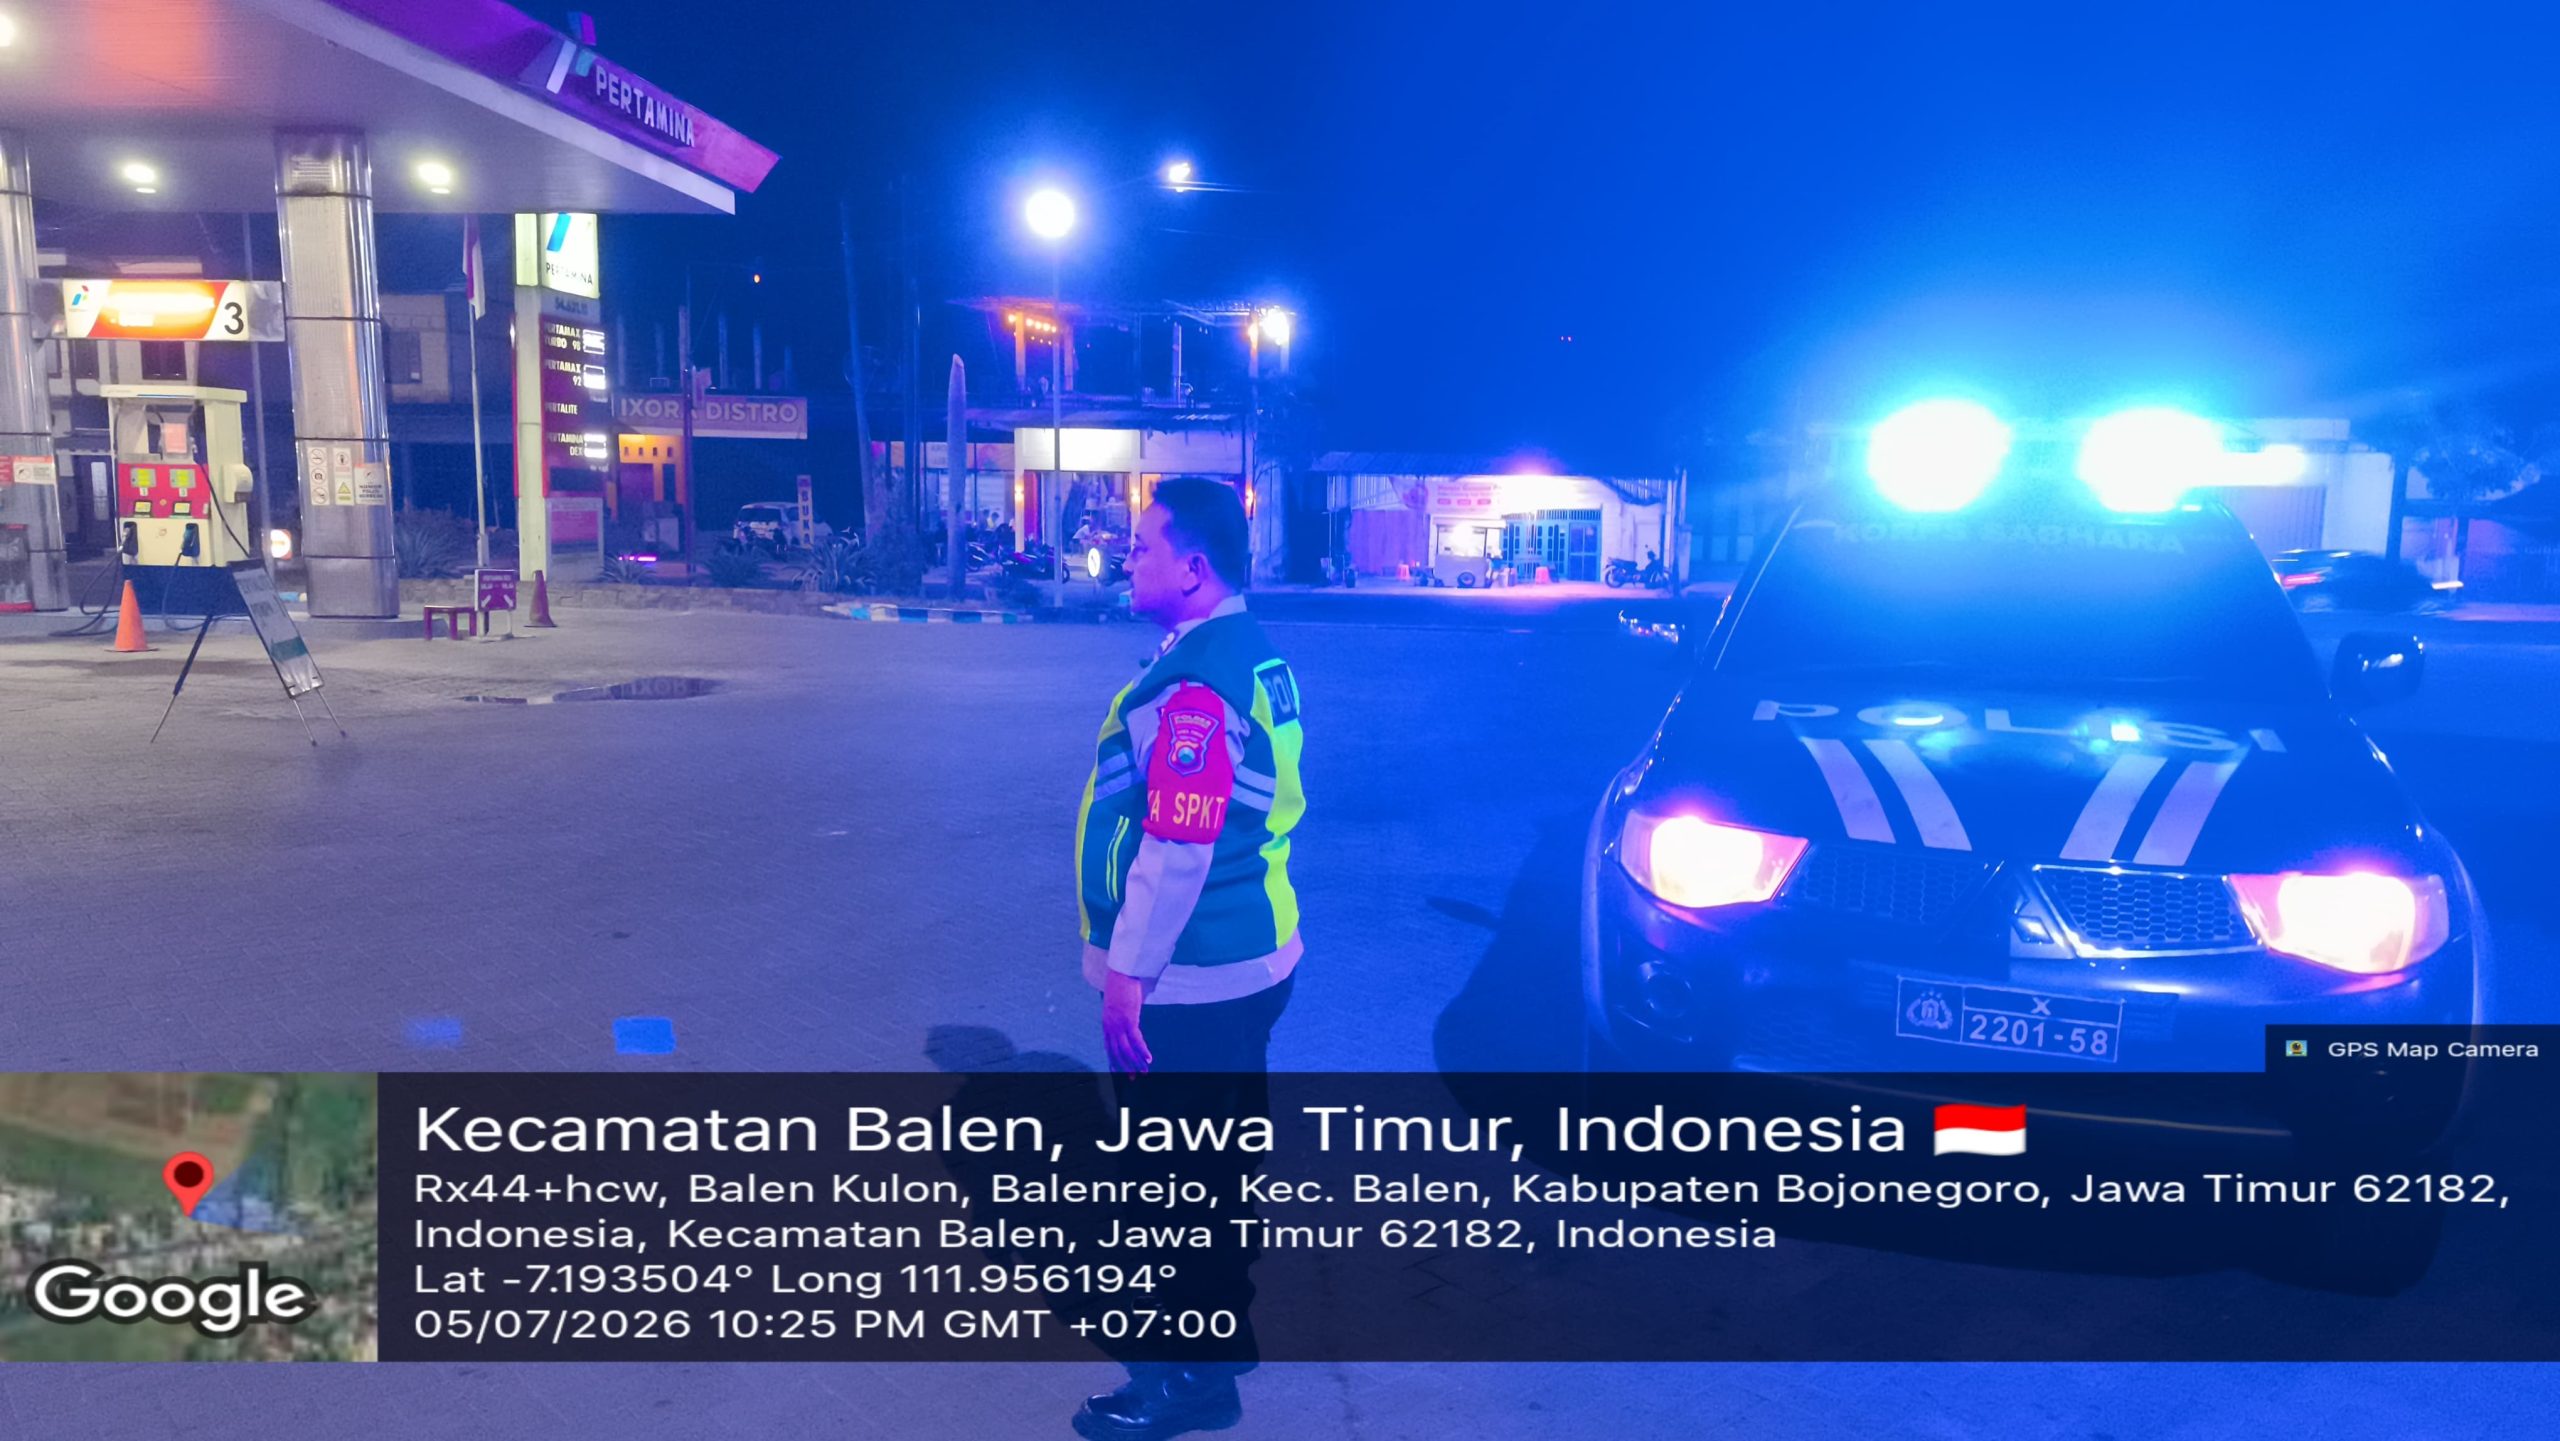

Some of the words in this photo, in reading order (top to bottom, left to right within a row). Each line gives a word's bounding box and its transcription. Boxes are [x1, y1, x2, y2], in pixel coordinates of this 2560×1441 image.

[595, 64, 695, 148] PERTAMINA
[545, 262, 593, 285] PEMNA
[224, 301, 245, 335] 3
[572, 375, 582, 387] 92
[706, 401, 798, 423] DISTRO
[1752, 700, 2288, 753] POLSI
[1173, 791, 1225, 830] SPKT
[2031, 996, 2052, 1017] X
[1968, 1013, 2109, 1056] 2201-58
